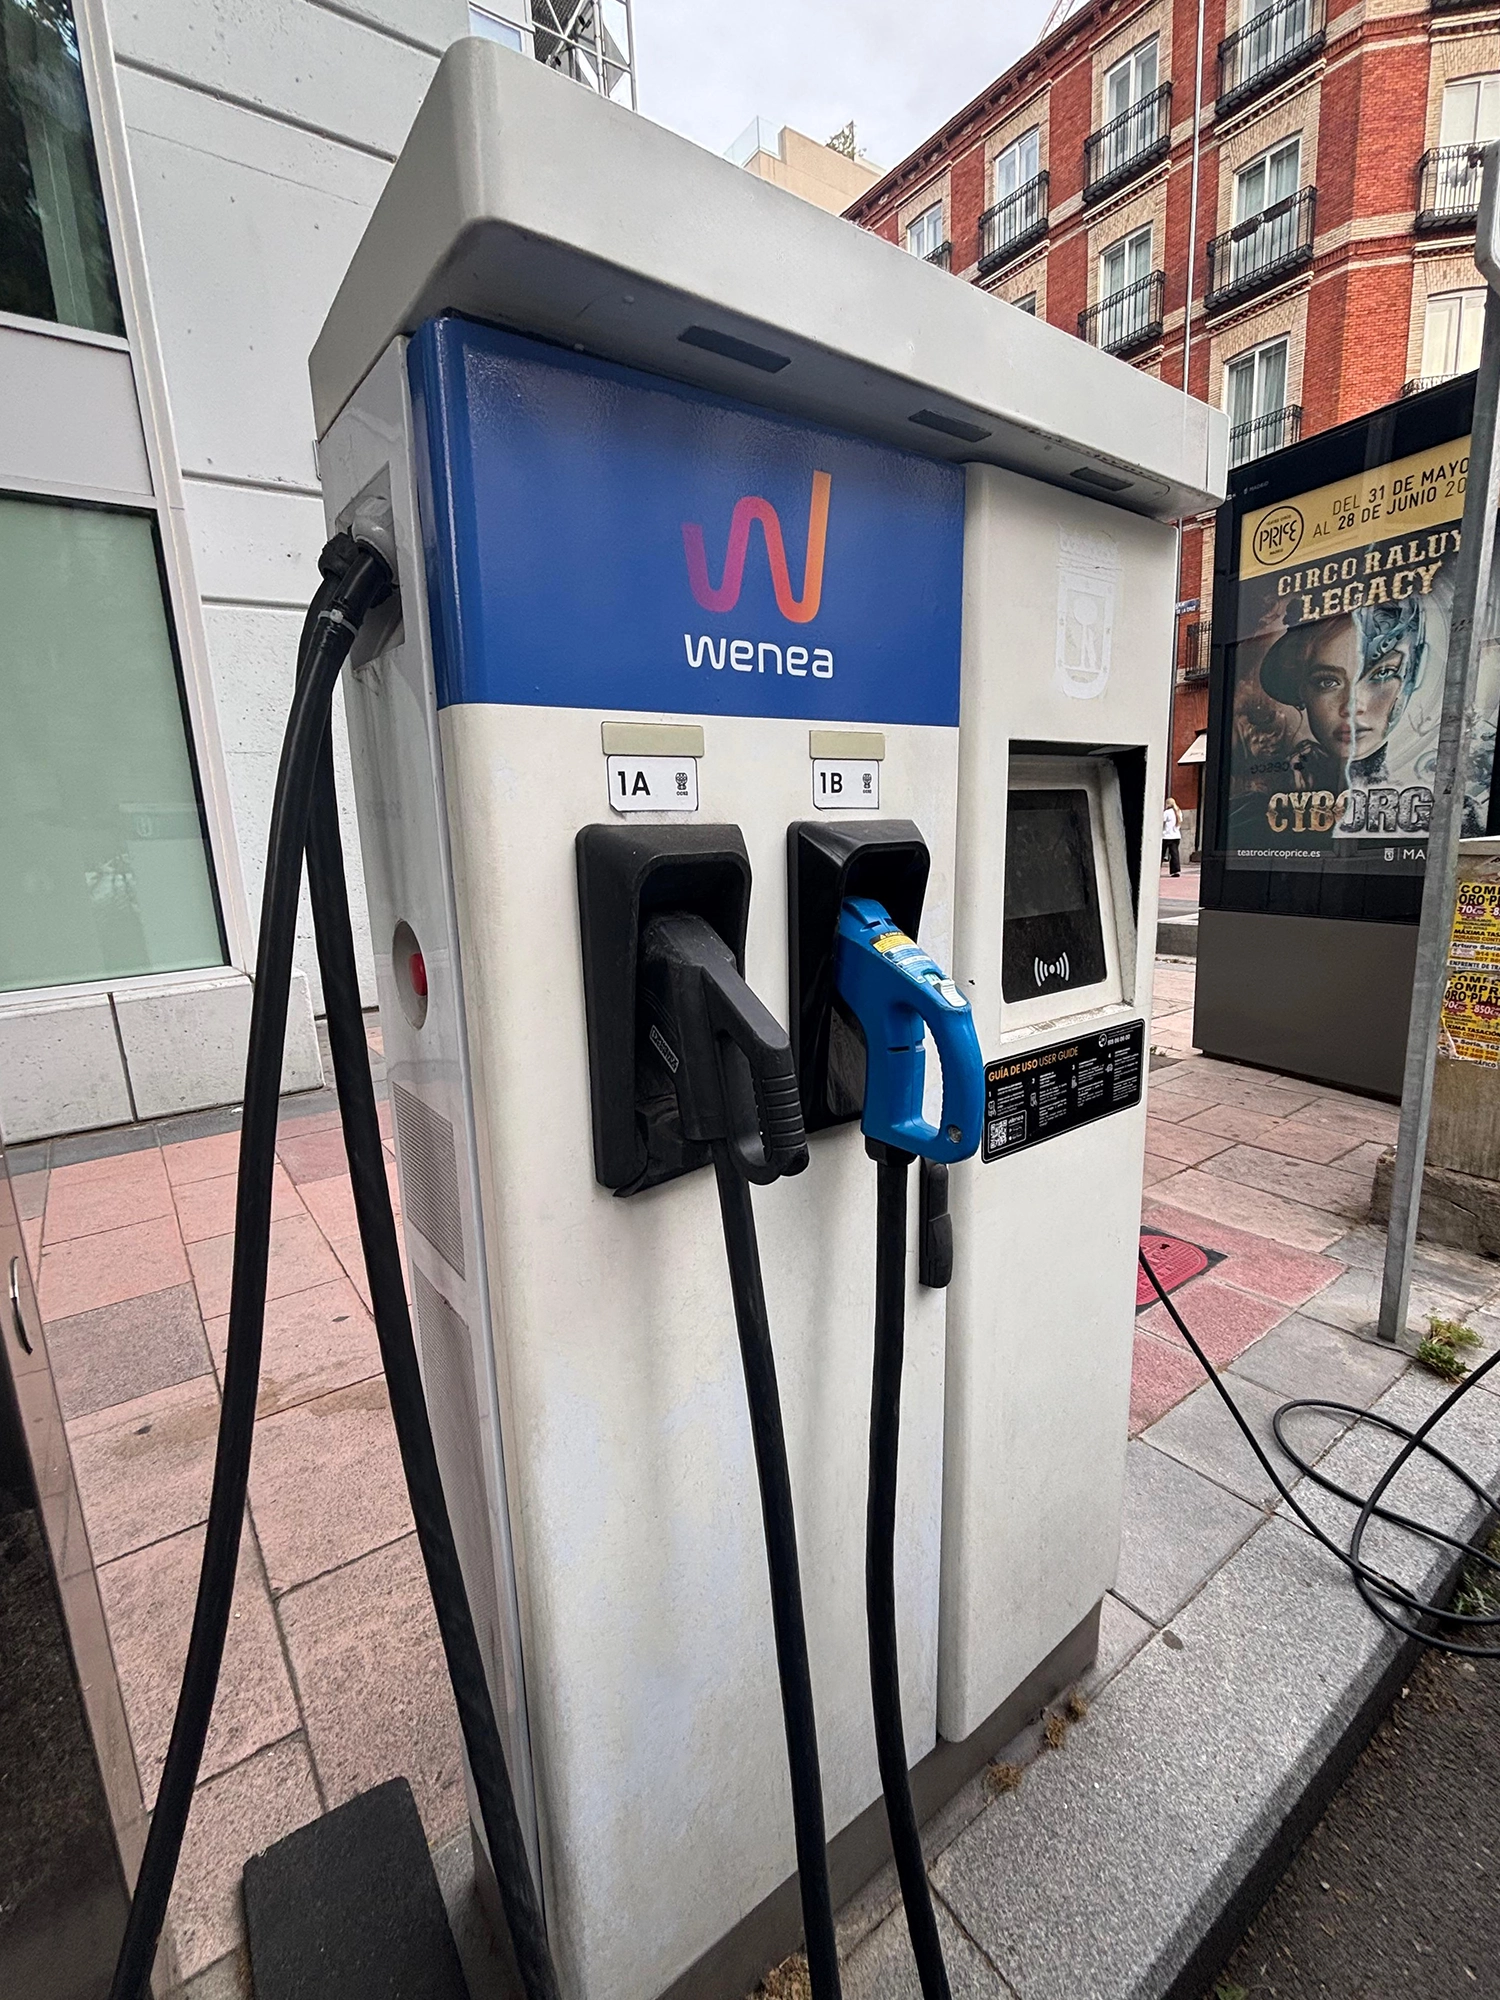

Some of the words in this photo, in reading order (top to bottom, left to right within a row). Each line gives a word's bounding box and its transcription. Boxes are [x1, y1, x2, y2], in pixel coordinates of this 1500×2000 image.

[1333, 494, 1360, 515] DEL
[1368, 485, 1385, 504] 31
[1393, 475, 1414, 496] DE
[1421, 457, 1470, 487] MAYO
[1313, 522, 1330, 538] AL
[1338, 513, 1355, 530] 28
[1361, 504, 1380, 524] DE
[1386, 486, 1437, 515] JUNIO
[1444, 476, 1466, 498] 20
[1259, 520, 1298, 552] PRICE
[1278, 556, 1358, 597] CIRCO
[1364, 530, 1461, 576] RALUY
[1299, 561, 1442, 622] LEGACY
[684, 633, 834, 680] wenea
[617, 771, 651, 796] 1A
[820, 772, 842, 794] 1B
[1266, 786, 1434, 836] CYBORG
[1237, 848, 1321, 859] teatrocircoprice.es
[1403, 849, 1426, 860] MA
[1459, 894, 1485, 906] ORO
[1460, 884, 1500, 894] COM
[1445, 990, 1466, 1002] ORO
[988, 1065, 1009, 1082] GUÍA
[1011, 1065, 1020, 1076] DE
[1022, 1059, 1038, 1072] USO
[1039, 1054, 1056, 1068] USER
[1058, 1046, 1078, 1062] GUIDE
